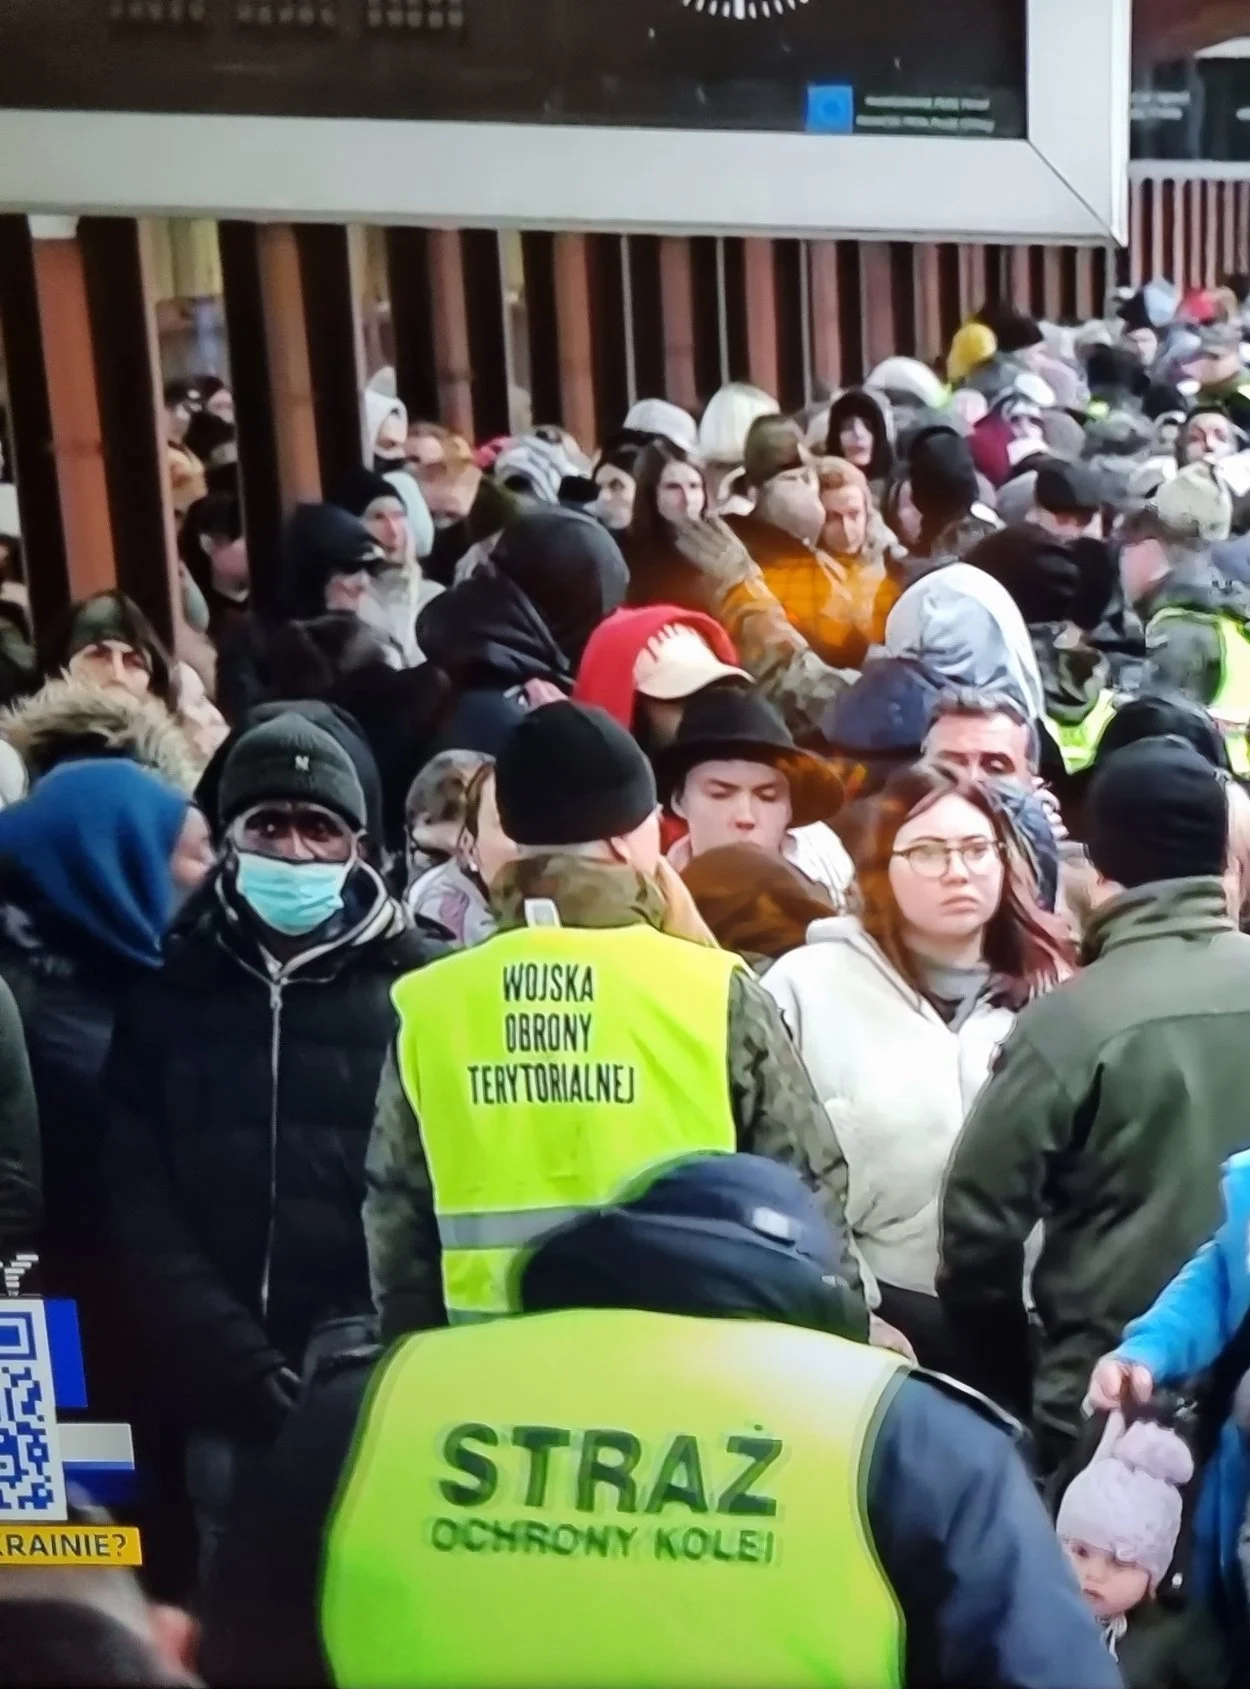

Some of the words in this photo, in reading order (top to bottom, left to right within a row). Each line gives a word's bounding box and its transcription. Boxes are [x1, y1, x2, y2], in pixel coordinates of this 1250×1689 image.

[502, 962, 595, 1003] WOJSKA
[504, 1012, 593, 1054] OBRONY
[467, 1063, 635, 1105] TERYTORIALNEJ
[437, 1422, 784, 1517] STRAŻ
[431, 1516, 640, 1559] OCHRONY
[654, 1526, 774, 1564] KOLEI
